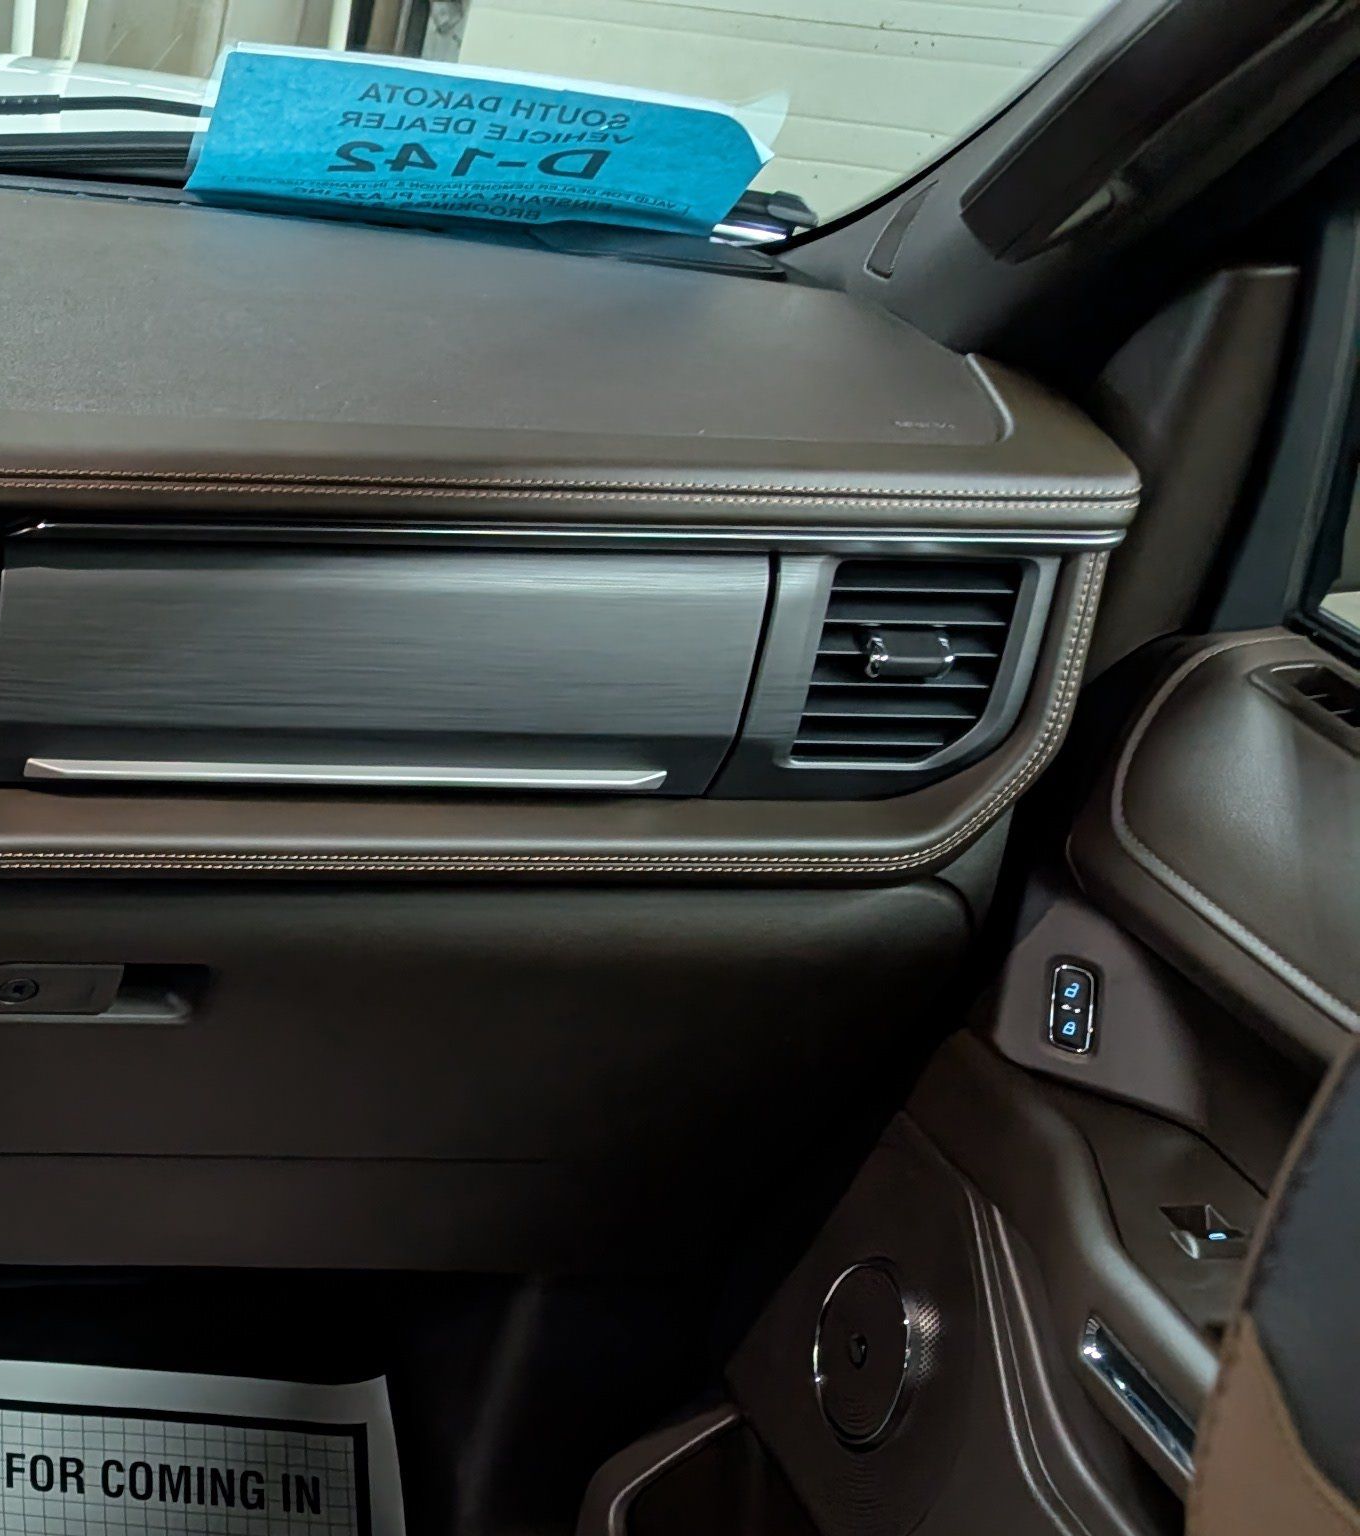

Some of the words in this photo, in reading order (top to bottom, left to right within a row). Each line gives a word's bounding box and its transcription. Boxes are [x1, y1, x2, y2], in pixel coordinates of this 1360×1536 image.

[4, 1452, 85, 1496] FOR
[100, 1459, 266, 1511] COMING
[281, 1472, 322, 1515] IN
